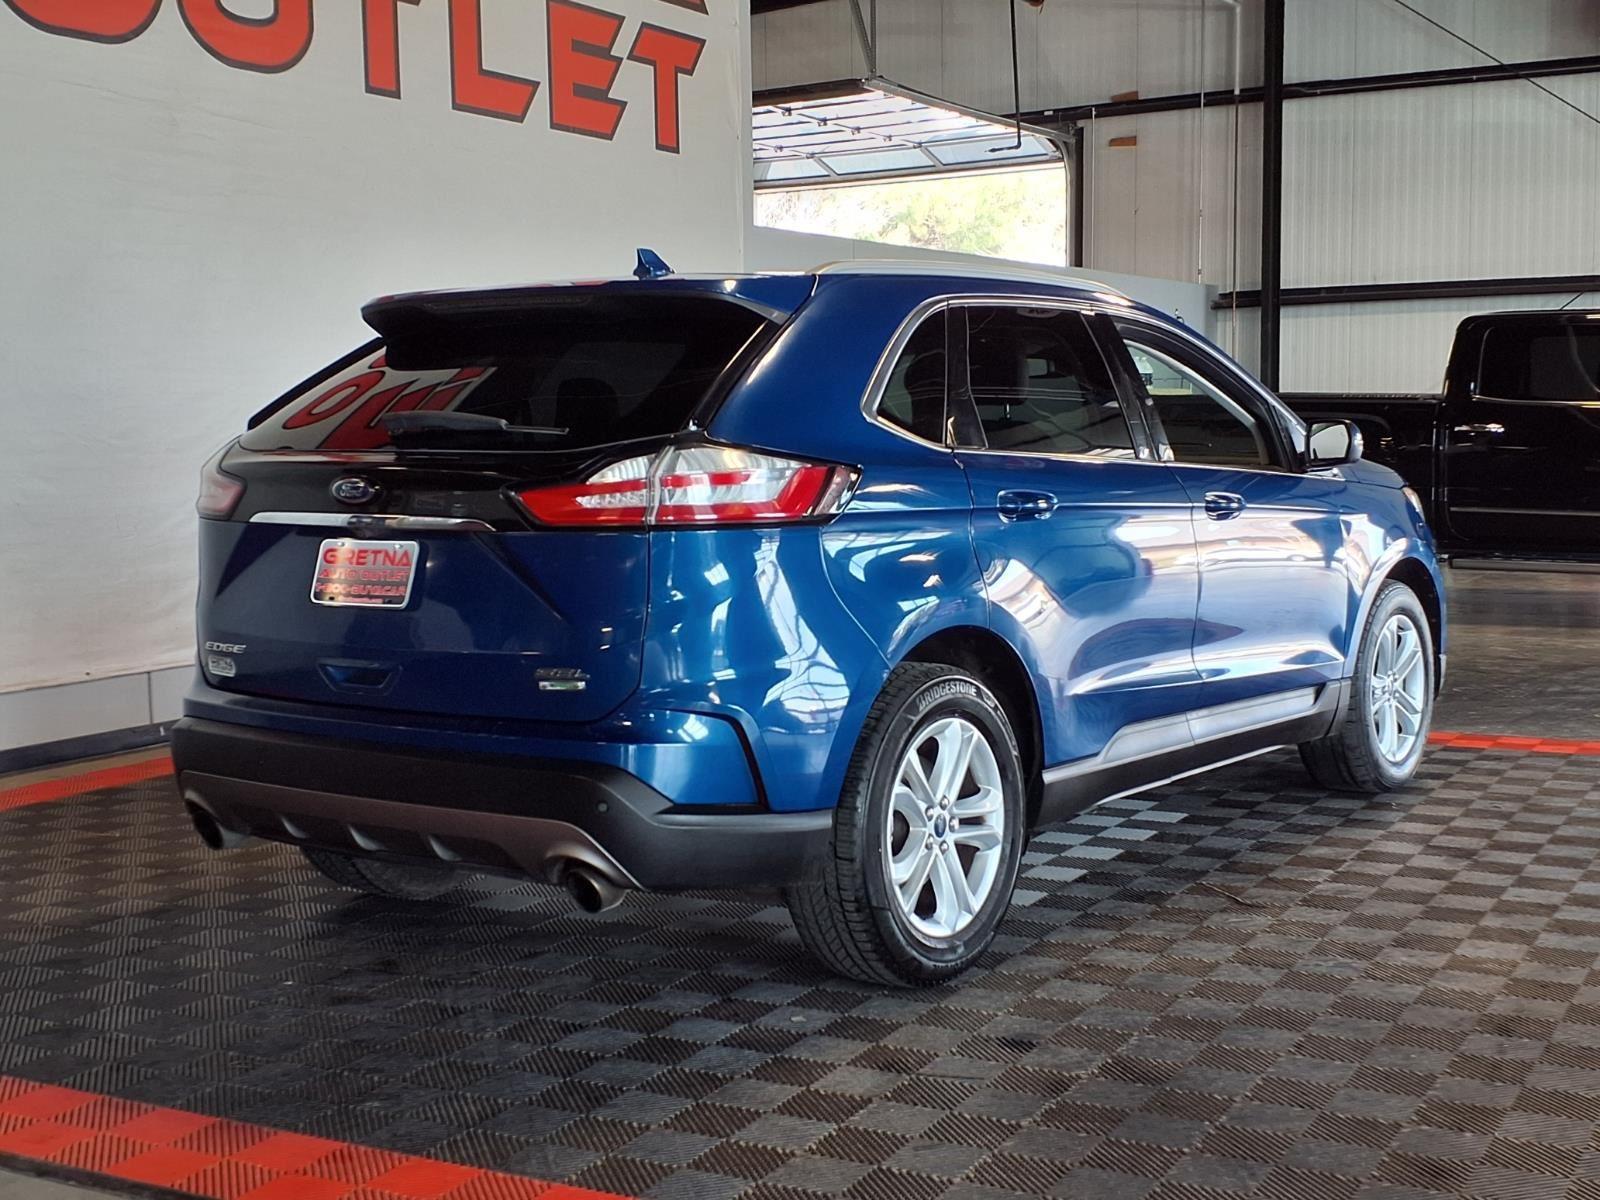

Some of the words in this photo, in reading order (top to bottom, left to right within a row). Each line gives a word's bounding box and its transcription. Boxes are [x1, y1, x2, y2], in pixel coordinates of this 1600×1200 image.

[0, 0, 706, 154] TLET
[322, 547, 412, 567] GRETNA
[319, 567, 356, 580] AUTO
[359, 569, 409, 582] OUTLET
[204, 641, 248, 654] EDGE
[916, 681, 978, 711] BRIDGESTONE
